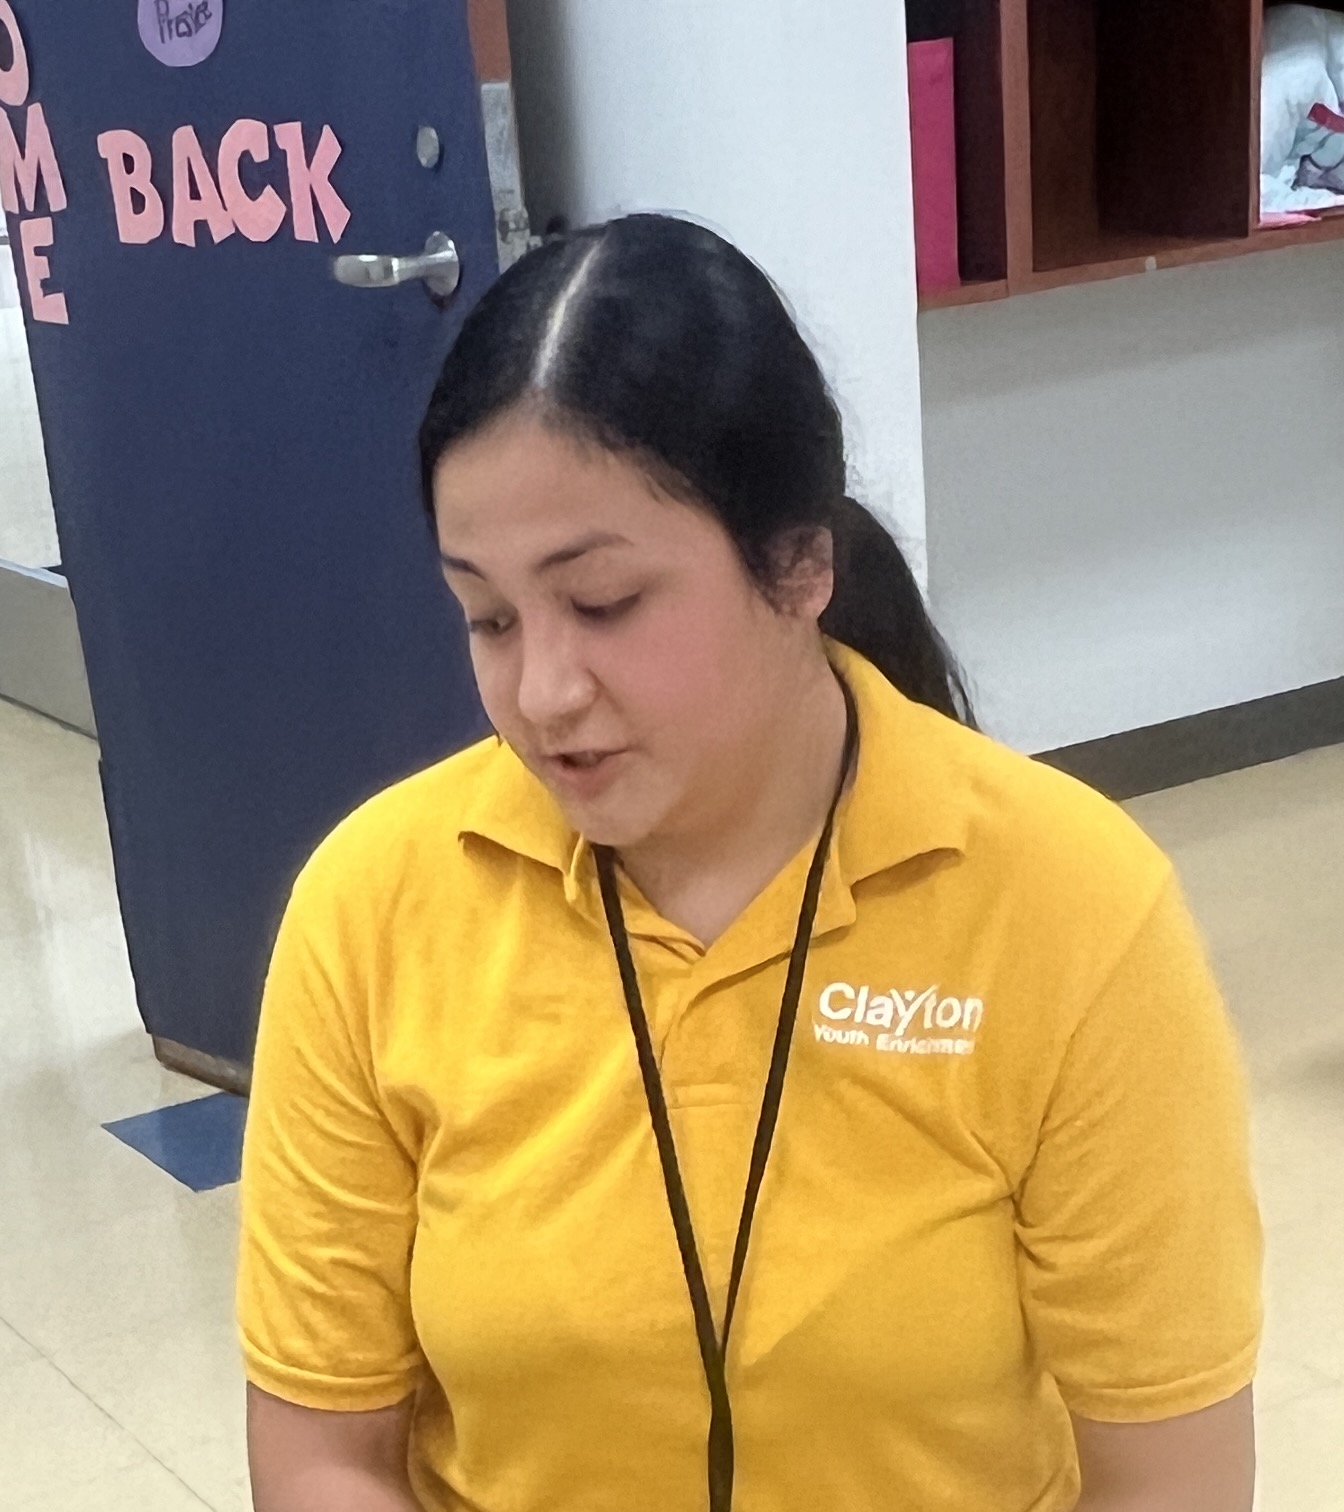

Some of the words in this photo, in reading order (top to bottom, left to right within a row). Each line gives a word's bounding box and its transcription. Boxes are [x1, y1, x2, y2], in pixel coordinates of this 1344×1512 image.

[97, 118, 352, 248] BACK
[819, 982, 984, 1036] Clayton
[812, 1021, 869, 1047] Youth
[876, 1032, 976, 1056] Enrichme
